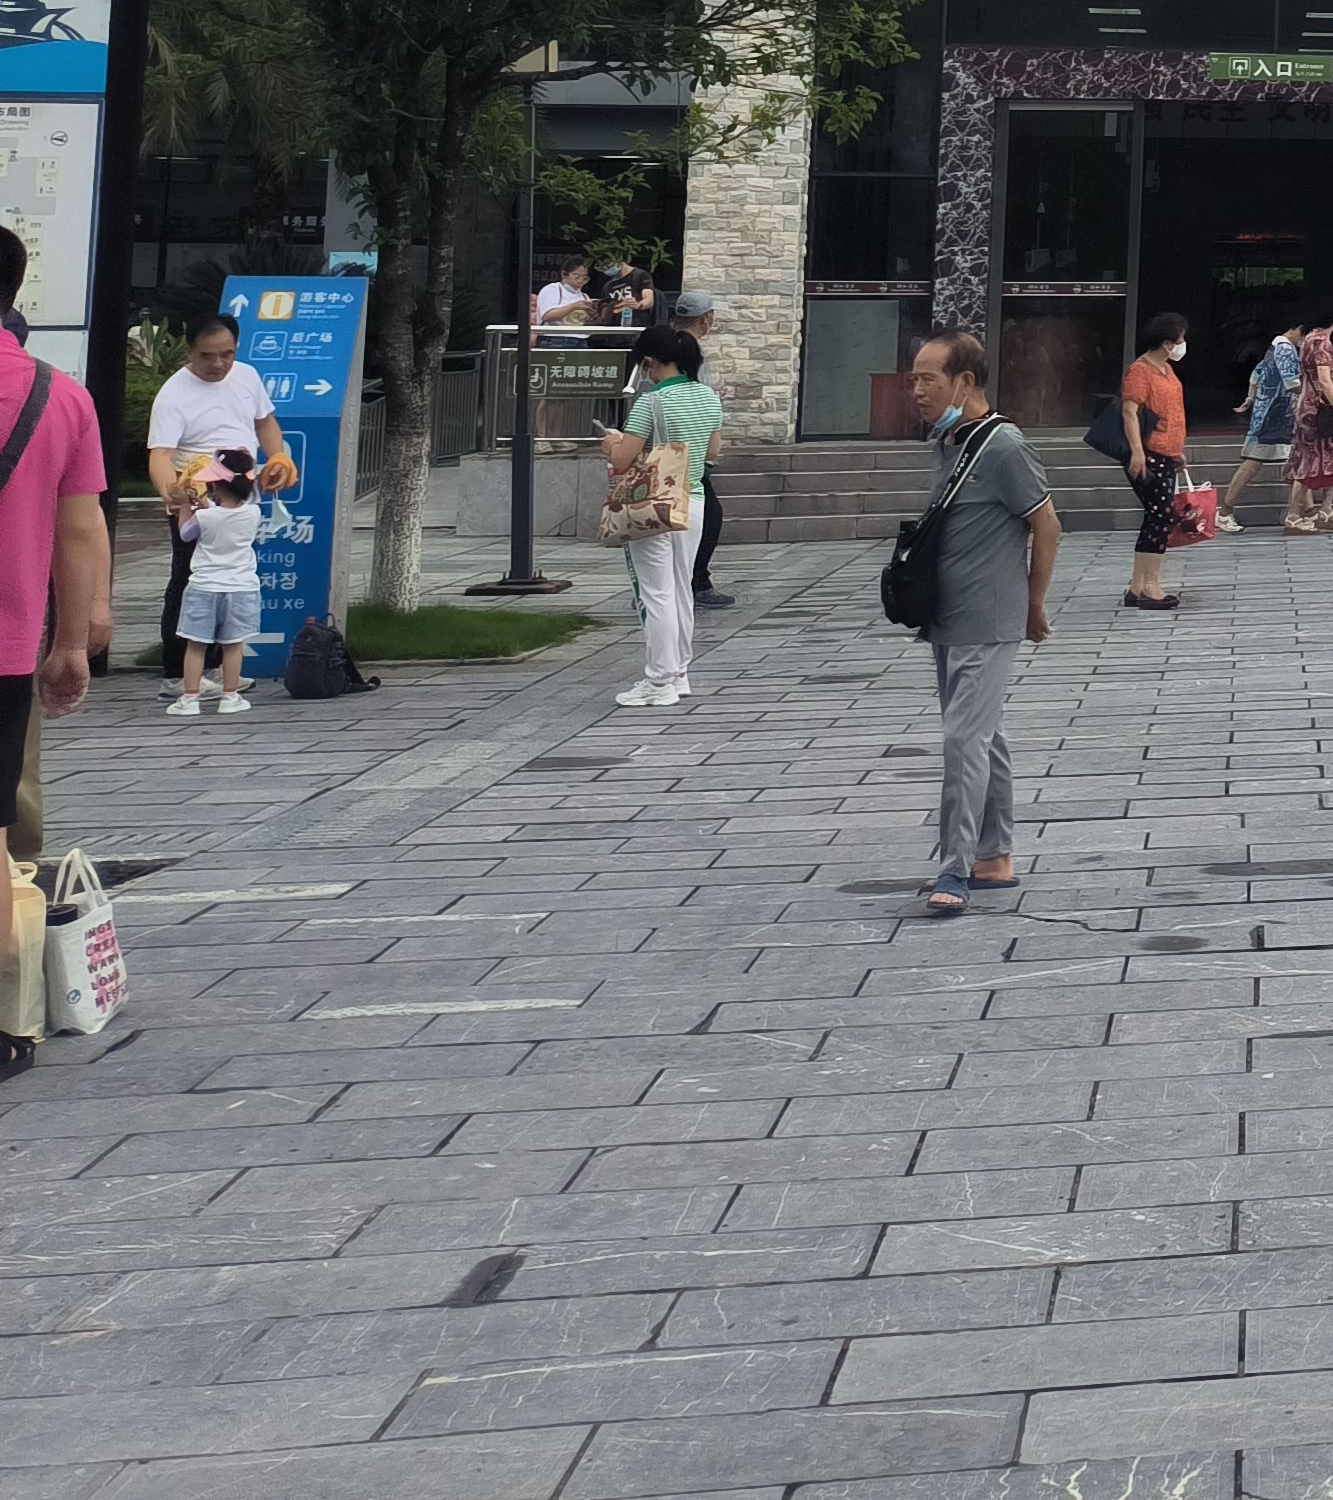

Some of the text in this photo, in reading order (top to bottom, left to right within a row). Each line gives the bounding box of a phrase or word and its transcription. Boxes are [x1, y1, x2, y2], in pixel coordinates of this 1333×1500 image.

[1253, 59, 1292, 77] 入口
[299, 292, 354, 304] 游客中心
[290, 332, 333, 343] 后广场
[549, 365, 618, 379] 无障碍坡道
[257, 514, 315, 545] 车场
[257, 550, 295, 568] king
[259, 572, 298, 590] 차장
[283, 598, 305, 610] xe
